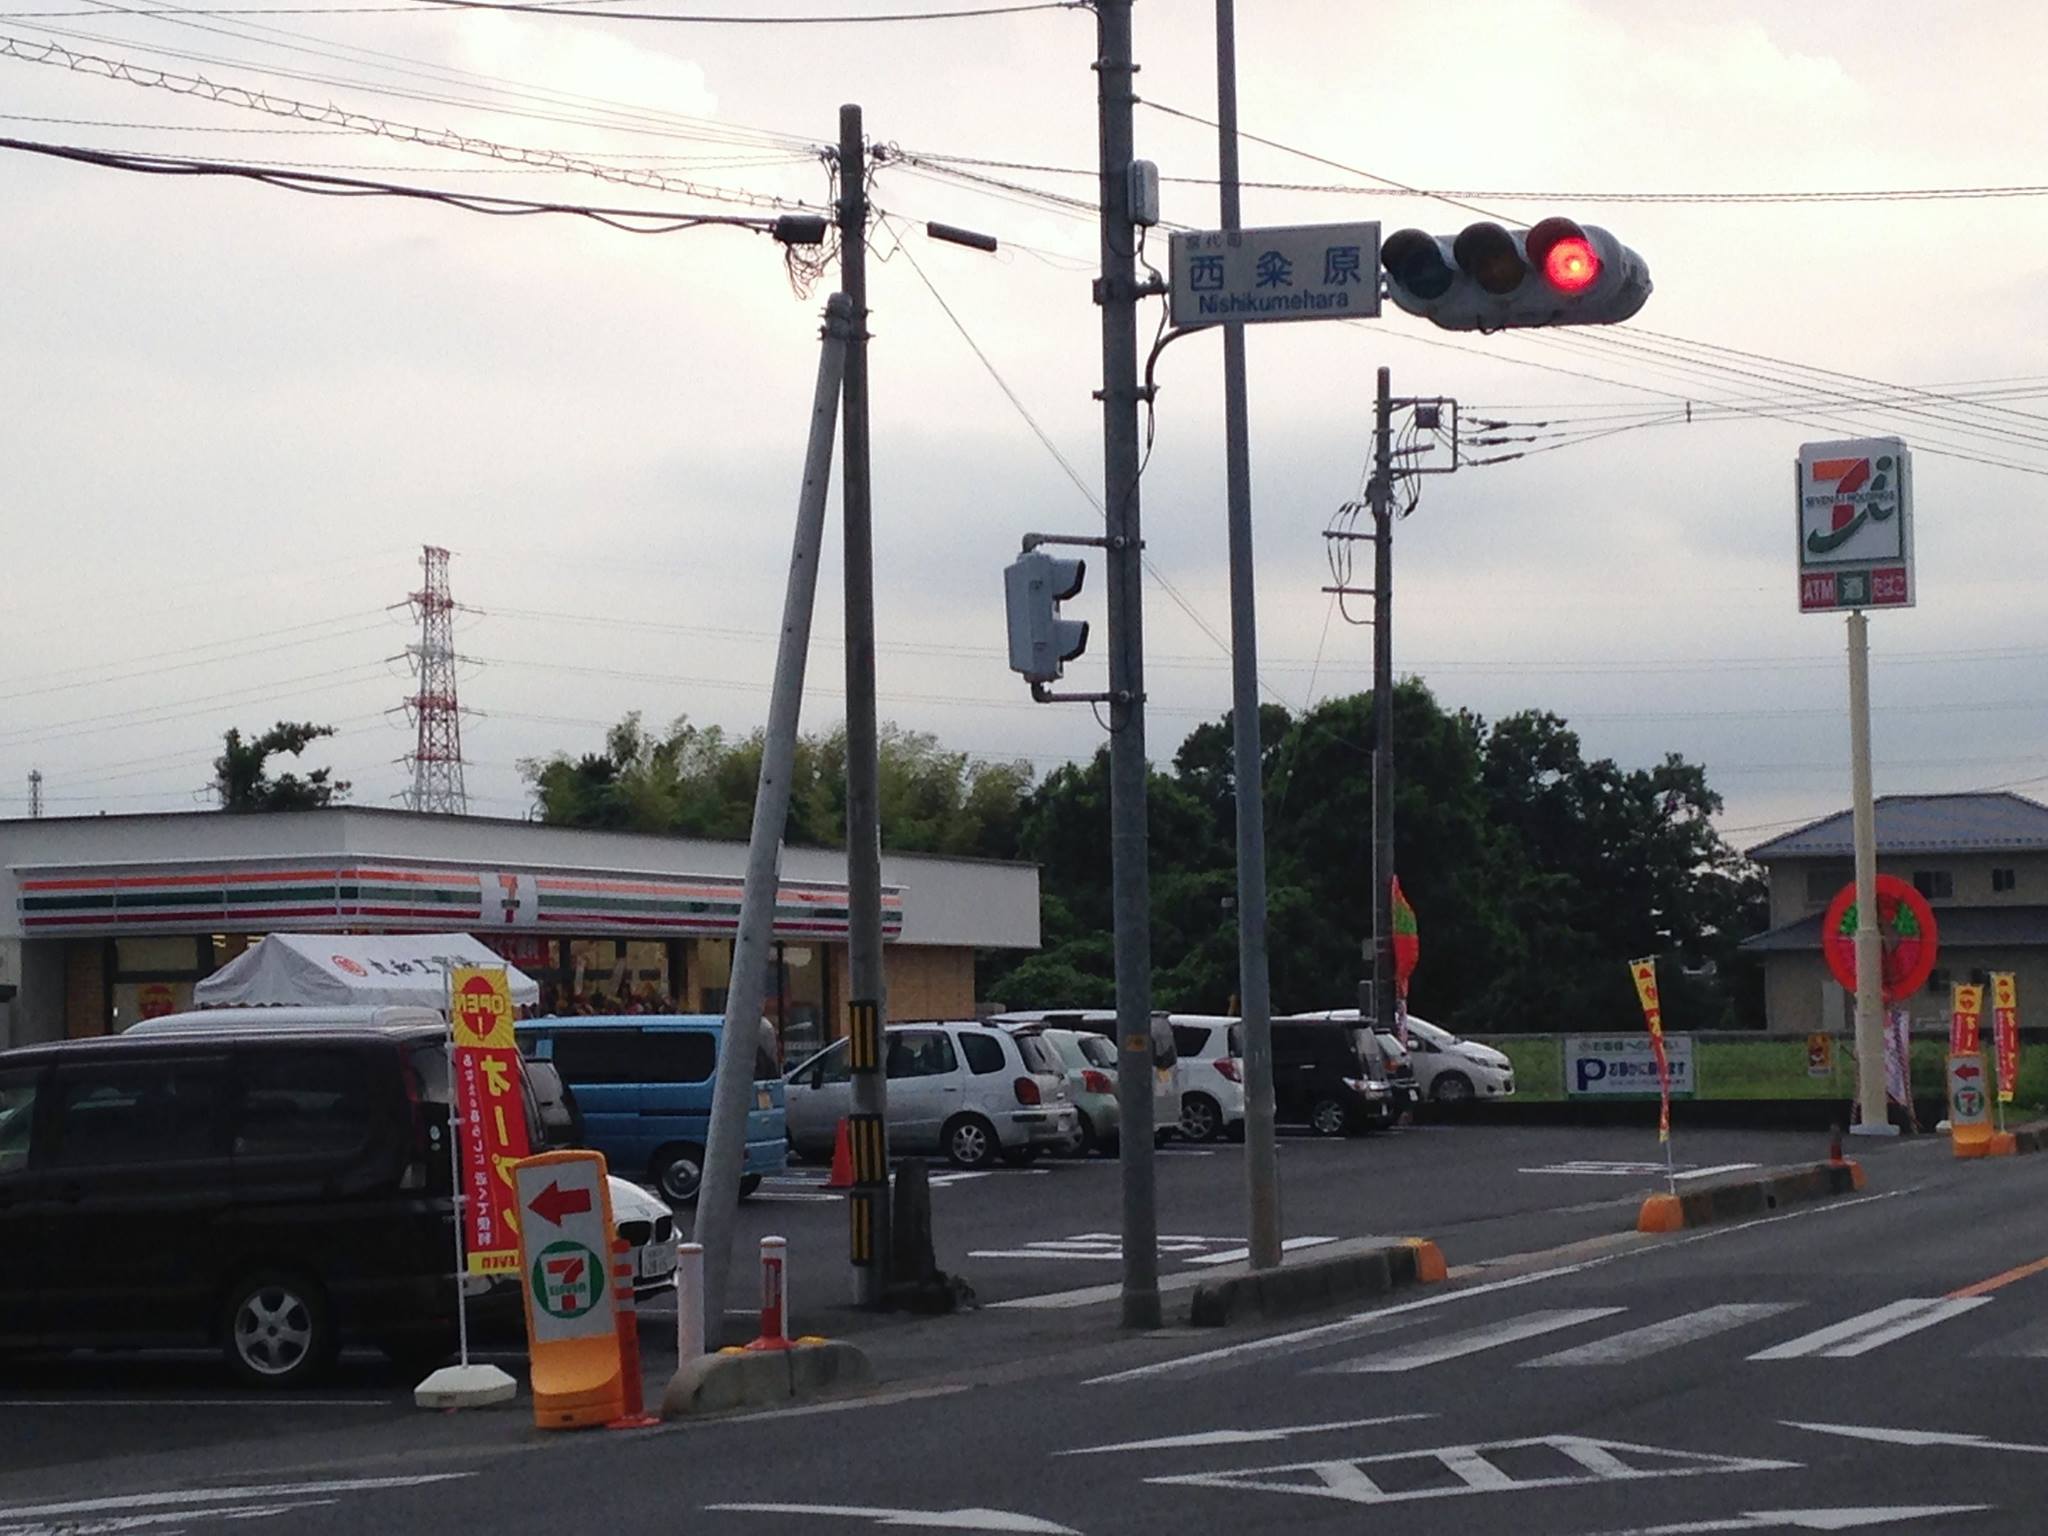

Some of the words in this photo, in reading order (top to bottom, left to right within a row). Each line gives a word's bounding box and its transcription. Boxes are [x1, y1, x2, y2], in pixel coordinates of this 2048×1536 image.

[1190, 247, 1361, 292] 西粂原
[1199, 289, 1349, 314] Nishikumehara
[1803, 579, 1835, 601] ATM
[1576, 1058, 1607, 1091] P
